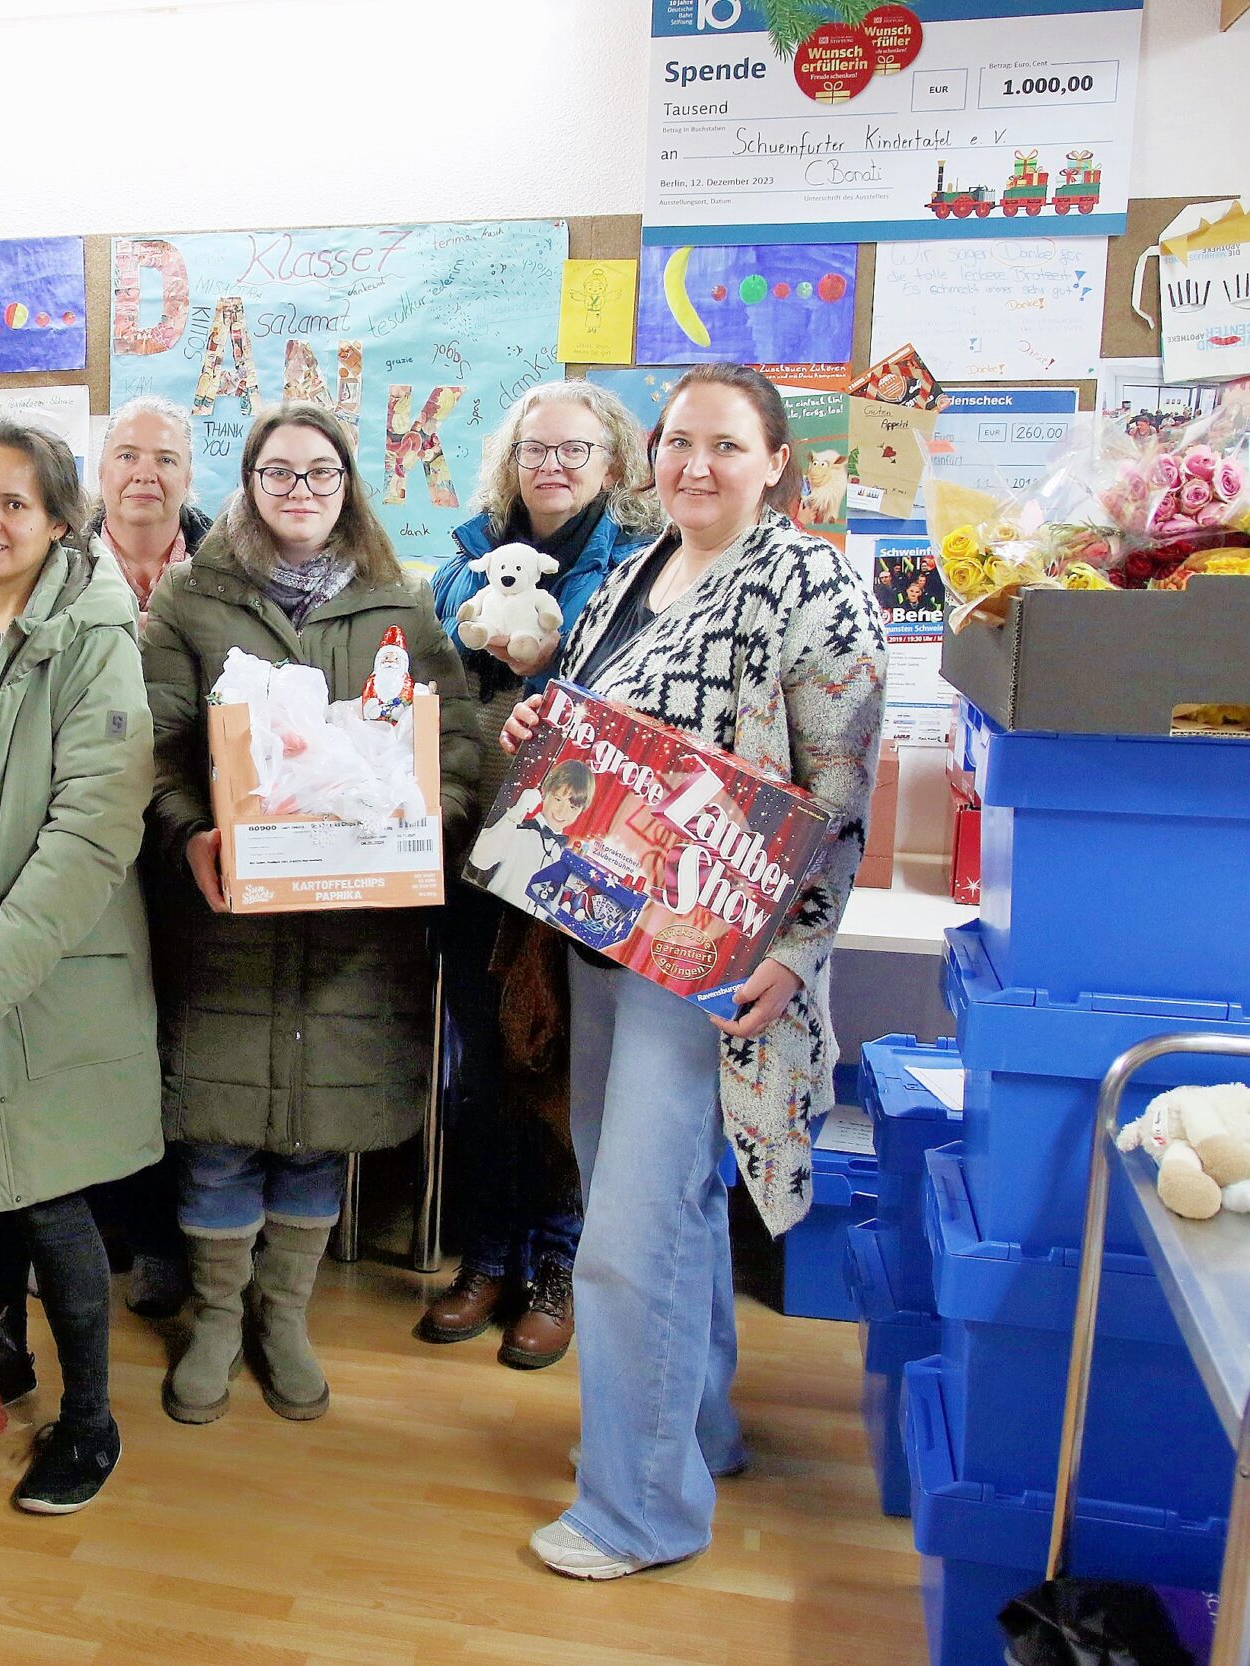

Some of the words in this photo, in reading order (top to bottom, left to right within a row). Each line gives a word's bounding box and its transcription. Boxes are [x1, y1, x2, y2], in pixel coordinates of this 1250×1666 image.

[865, 24, 912, 37] Wunsch
[872, 37, 910, 47] rfüller
[808, 45, 863, 59] Wunsch
[664, 57, 767, 87] Spende
[801, 57, 868, 73] erfüllerin
[929, 85, 948, 94] EUR
[1002, 75, 1093, 96] 1.000,00
[663, 101, 728, 116] Tausend
[865, 125, 951, 151] Kindertafel
[661, 150, 678, 160] an
[660, 179, 688, 188] Berlin,
[706, 178, 750, 186] Dezember
[752, 177, 774, 185] 2023
[238, 232, 374, 282] Klasse
[253, 298, 351, 338] salamat
[385, 355, 415, 372] grazie
[202, 421, 246, 438] THANK
[1016, 426, 1063, 440] 260,00
[202, 439, 231, 457] YOU
[399, 522, 431, 537] dank
[542, 687, 596, 748] Die
[661, 753, 795, 903] Zauber
[292, 878, 386, 892] KARTOFFELCHIPS
[663, 843, 771, 939] Show
[315, 890, 363, 902] PAPRIKA
[654, 941, 713, 964] garantiert
[658, 956, 706, 978] gelingen
